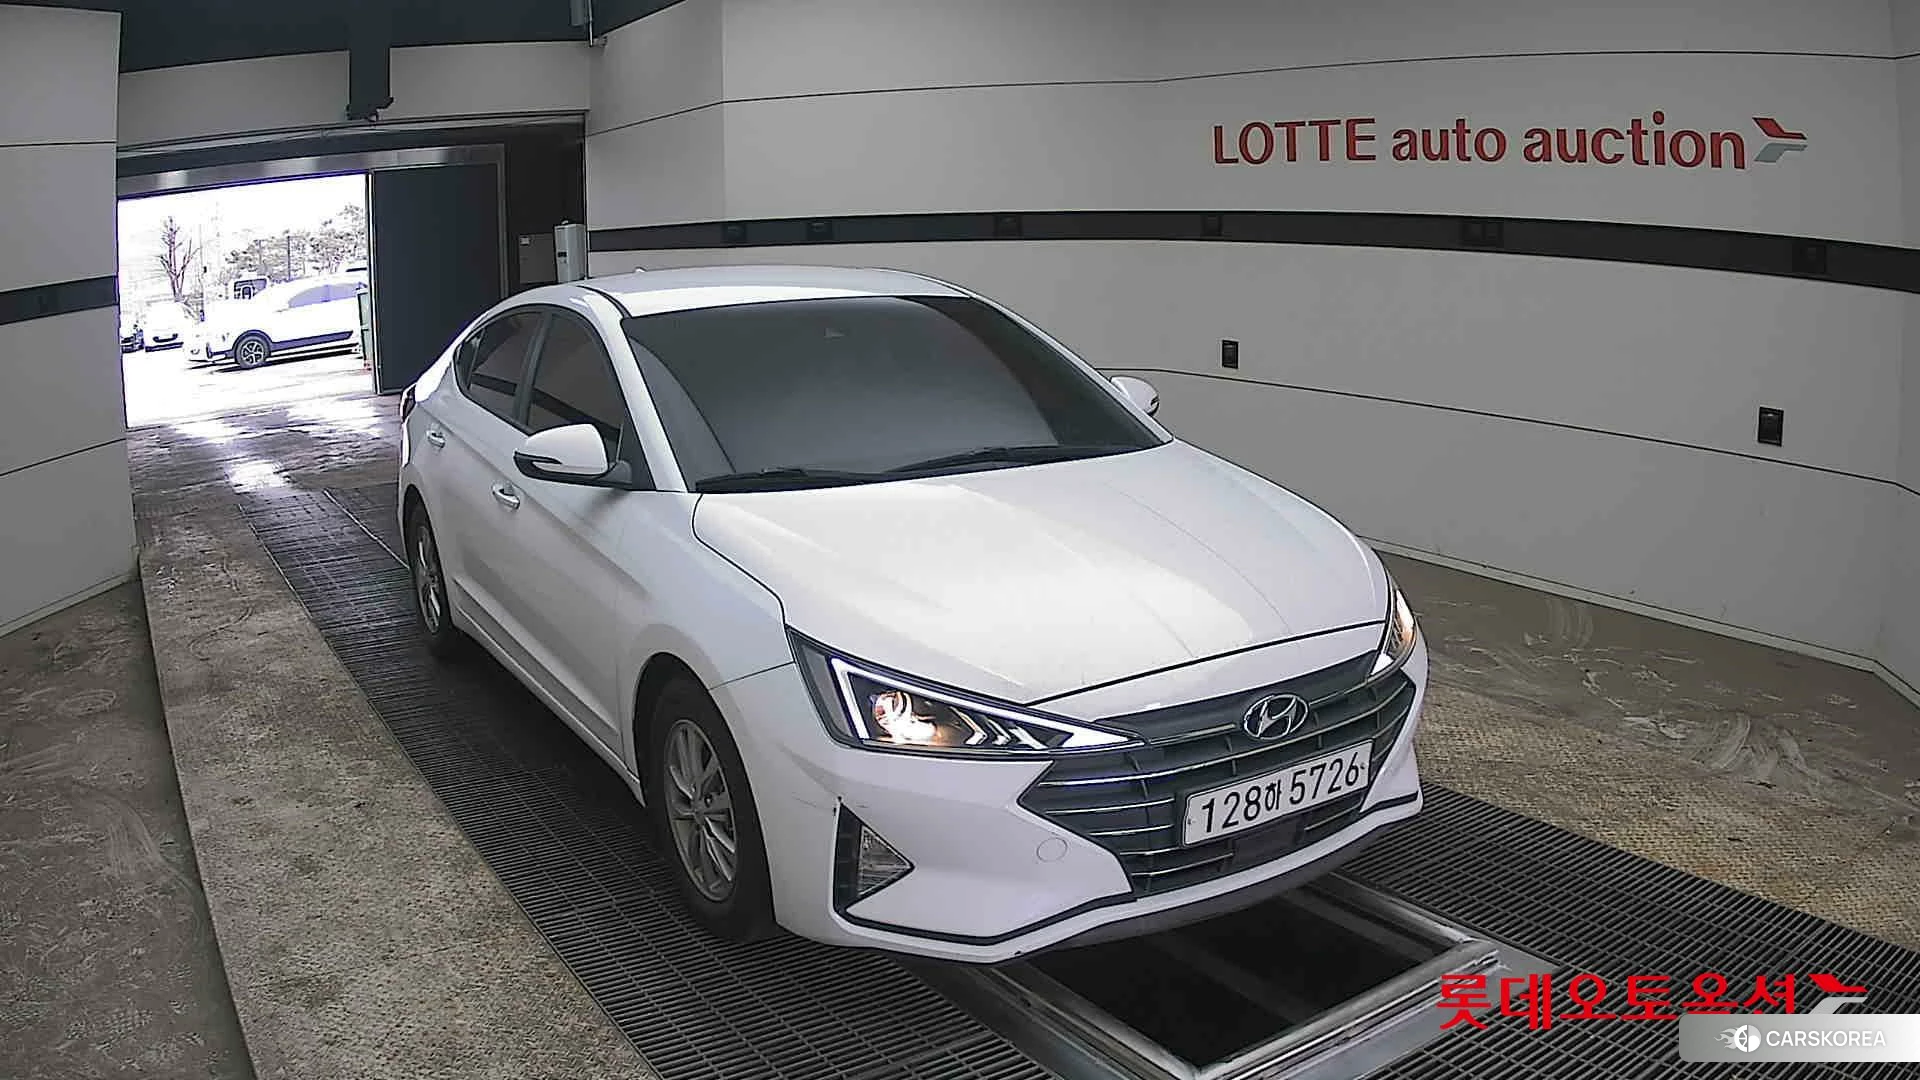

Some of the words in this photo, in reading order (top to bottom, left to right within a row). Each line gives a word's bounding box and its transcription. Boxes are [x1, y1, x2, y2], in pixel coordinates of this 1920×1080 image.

[1213, 118, 1376, 164] LOTTE
[1392, 118, 1507, 162] auto
[1523, 111, 1745, 169] auction
[1202, 780, 1282, 833] 128하
[1290, 751, 1360, 806] 5726
